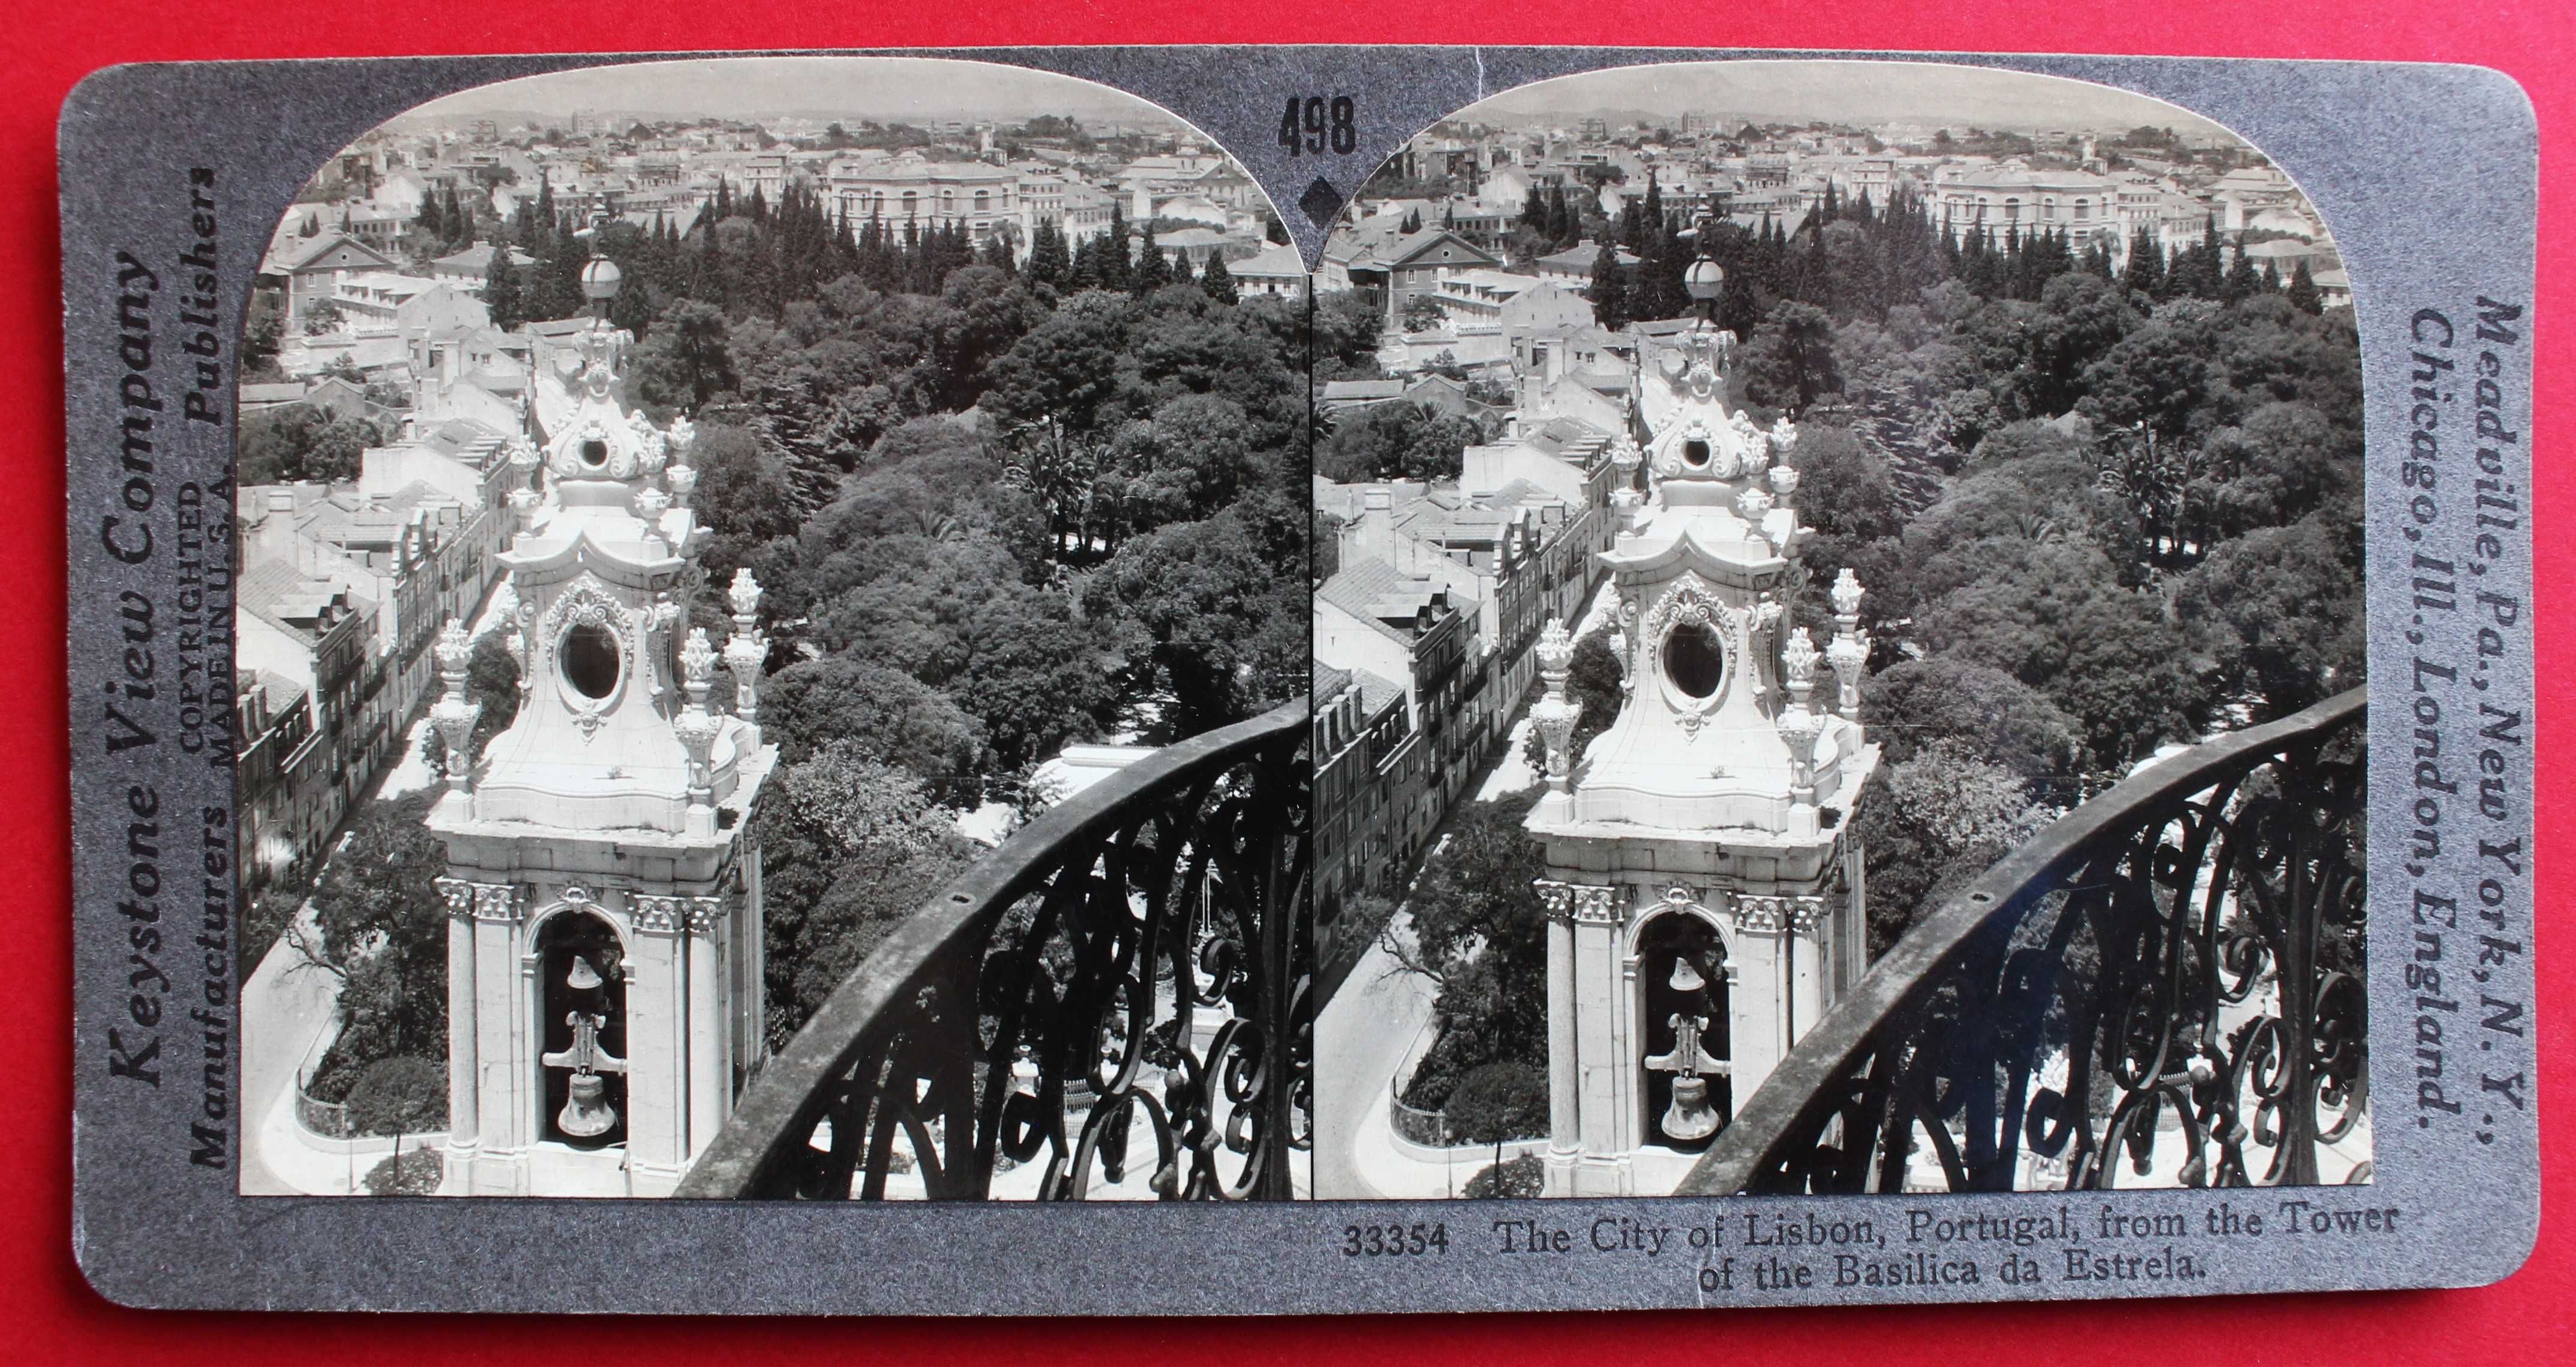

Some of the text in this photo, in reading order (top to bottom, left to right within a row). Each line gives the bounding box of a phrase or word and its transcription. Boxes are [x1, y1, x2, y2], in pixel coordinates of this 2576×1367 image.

[1278, 96, 1356, 157] 498
[102, 251, 170, 1089] Keystone View Company
[178, 481, 203, 754] COPYRIGHTED
[180, 167, 227, 1170] Manufacturers Publishers
[208, 464, 233, 769] MADE IN U. S. A.
[2402, 308, 2461, 1128] Chicago, Ill., London, England.
[2468, 296, 2523, 1144] Meadville, Pa., New York, N. Y.,
[1342, 1200, 2399, 1257] 33354 The City of Lisbon, Portugal, from the Tower
[1699, 1246, 2207, 1292] of the Basilica da Estrela.
